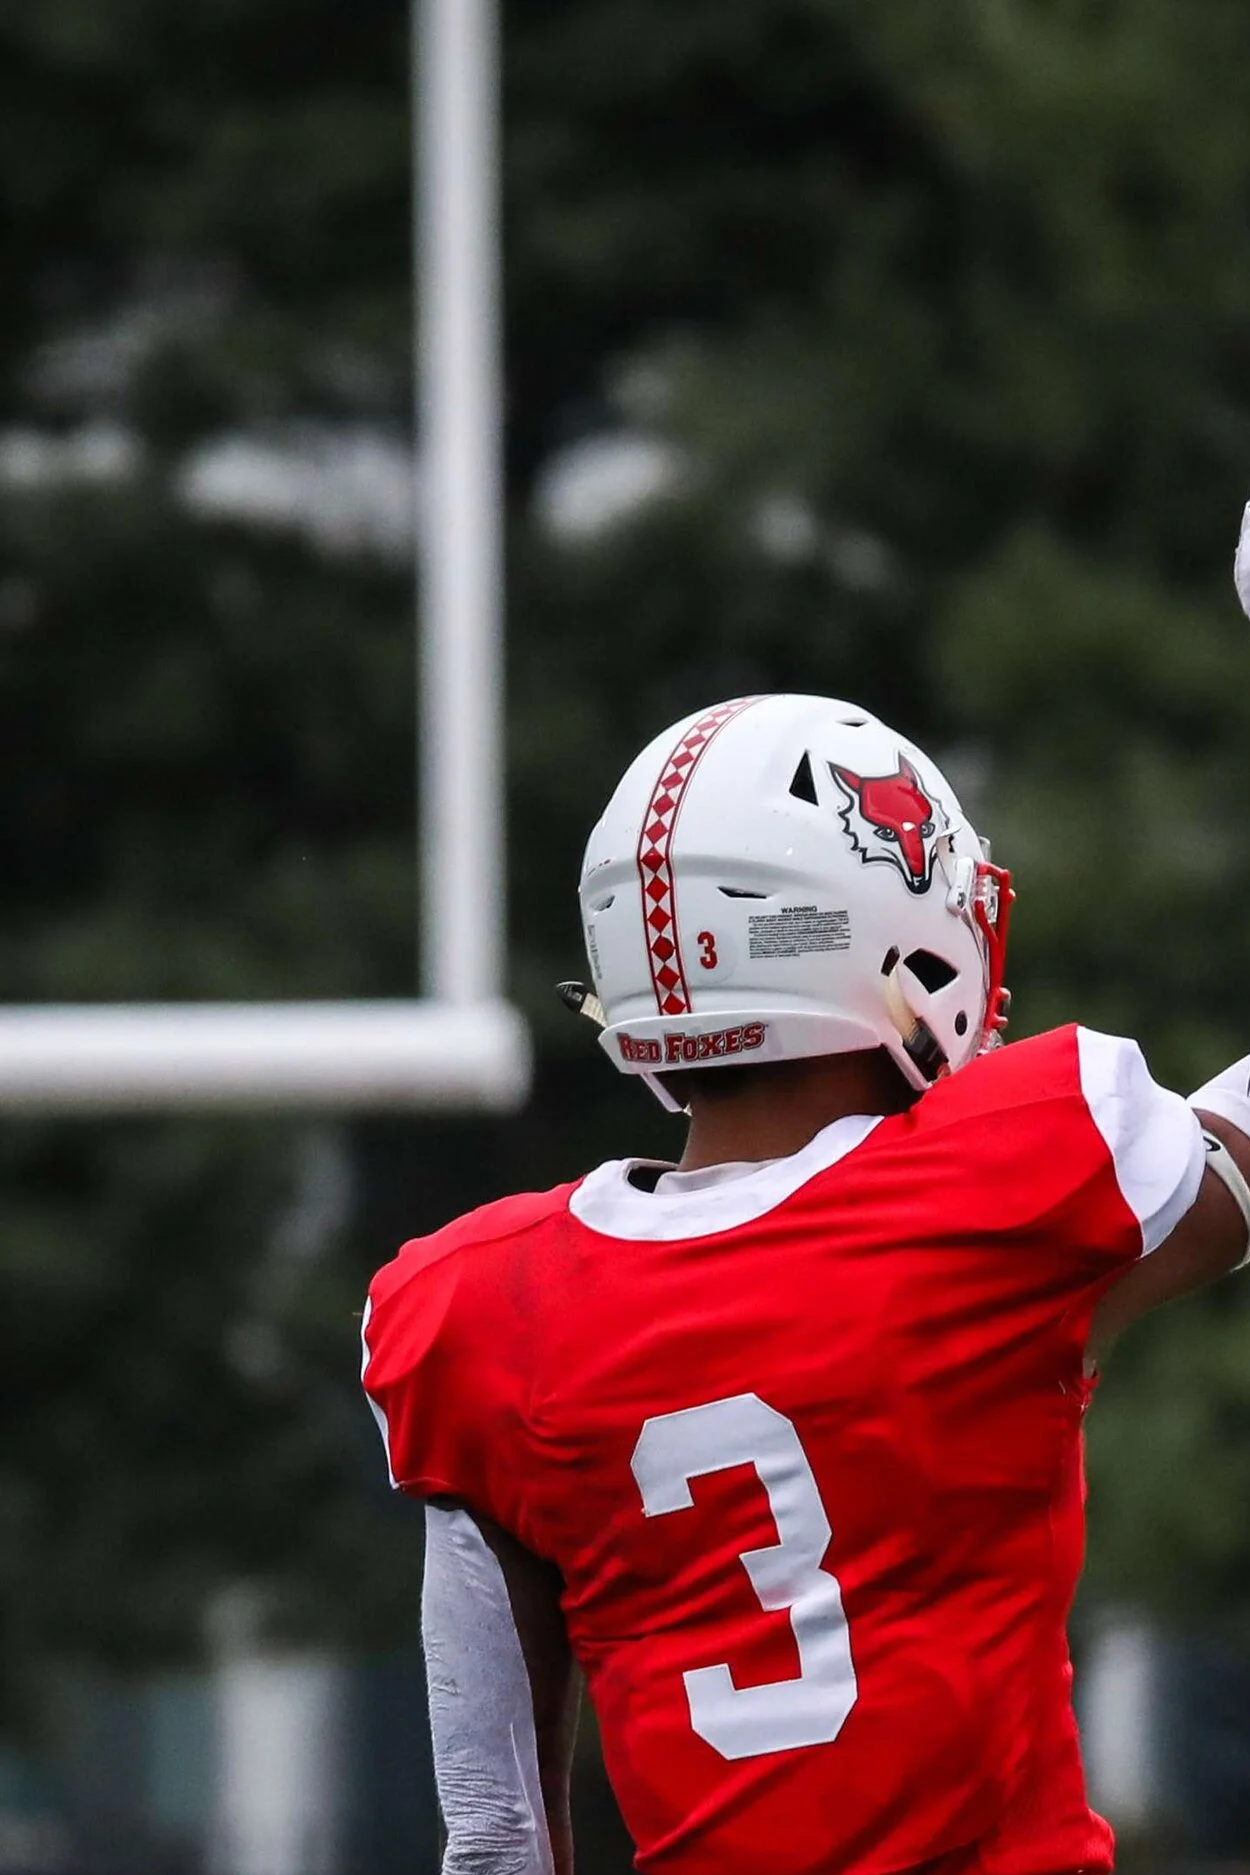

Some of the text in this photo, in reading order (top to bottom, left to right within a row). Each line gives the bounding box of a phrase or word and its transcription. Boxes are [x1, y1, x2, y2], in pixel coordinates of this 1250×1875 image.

[696, 931, 718, 970] 3
[617, 1021, 766, 1064] RED FOXES
[630, 1392, 858, 1761] 3
